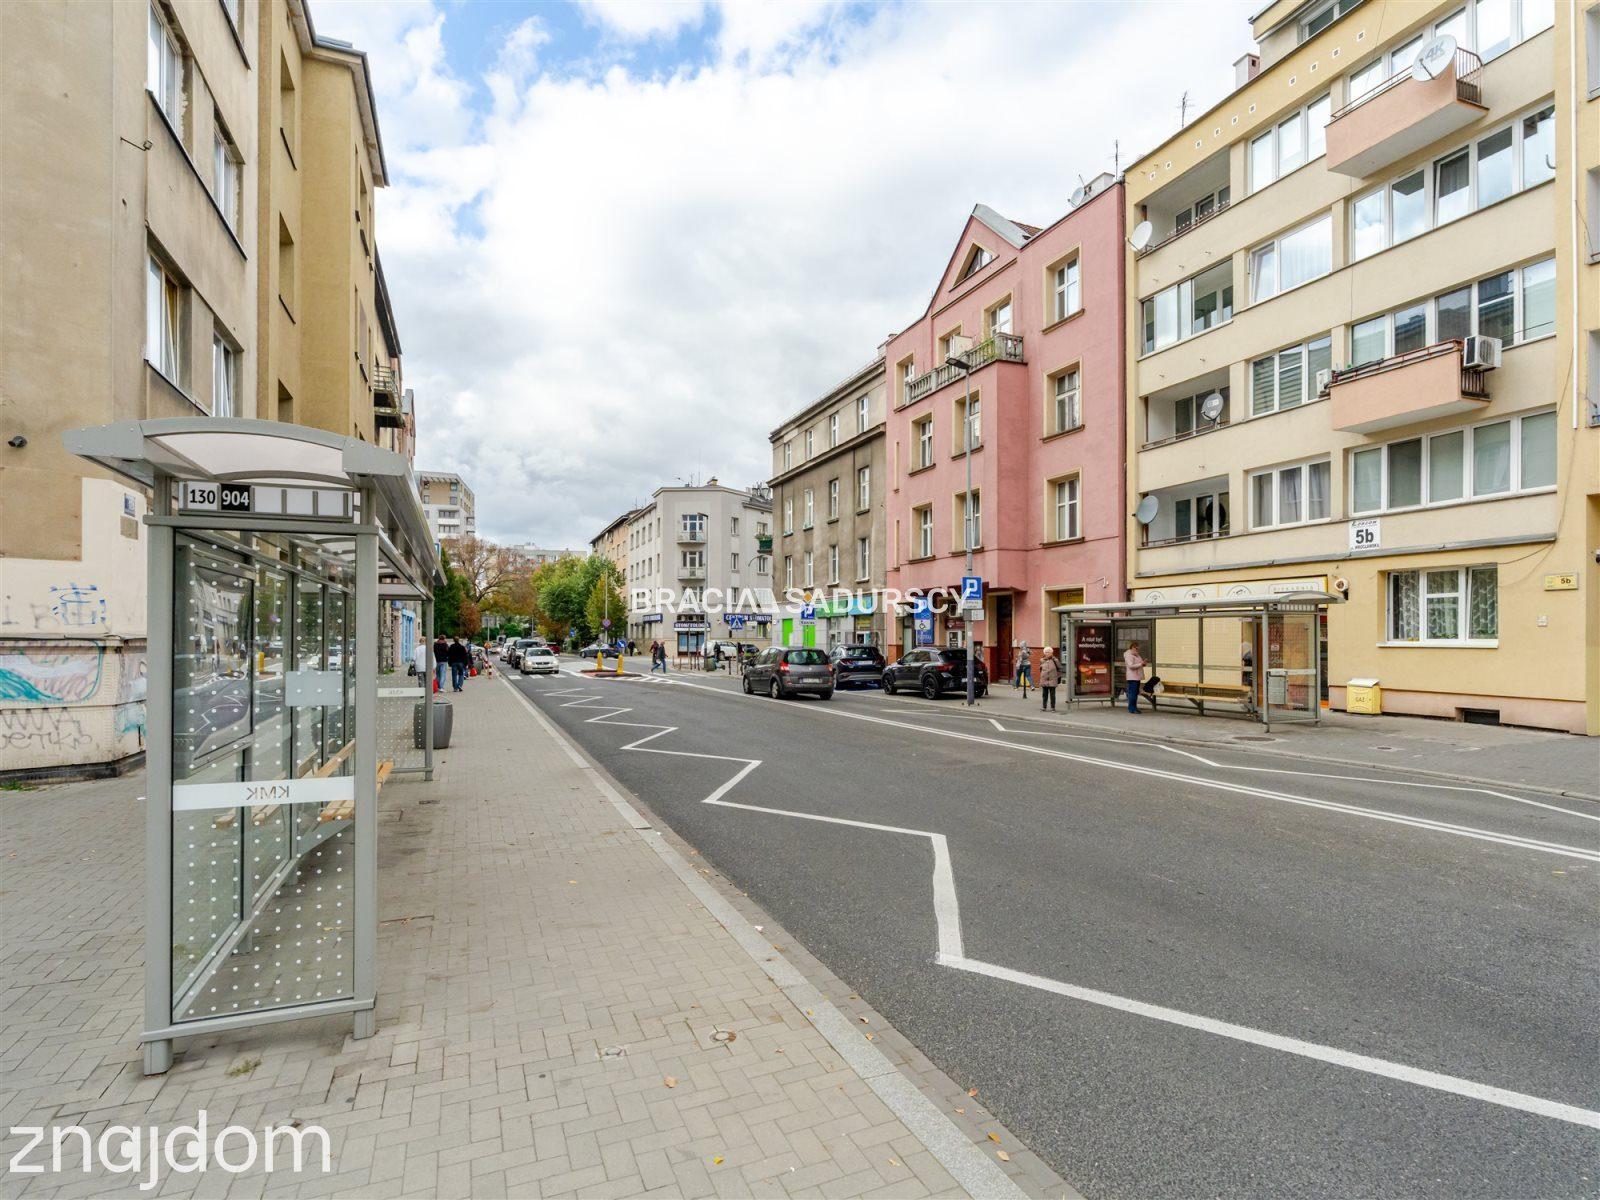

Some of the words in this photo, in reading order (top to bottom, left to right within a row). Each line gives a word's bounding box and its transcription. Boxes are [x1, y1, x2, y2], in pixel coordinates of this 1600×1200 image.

[189, 489, 216, 505] 130
[222, 490, 250, 506] 904
[1355, 528, 1374, 544] 5b
[966, 579, 978, 596] P
